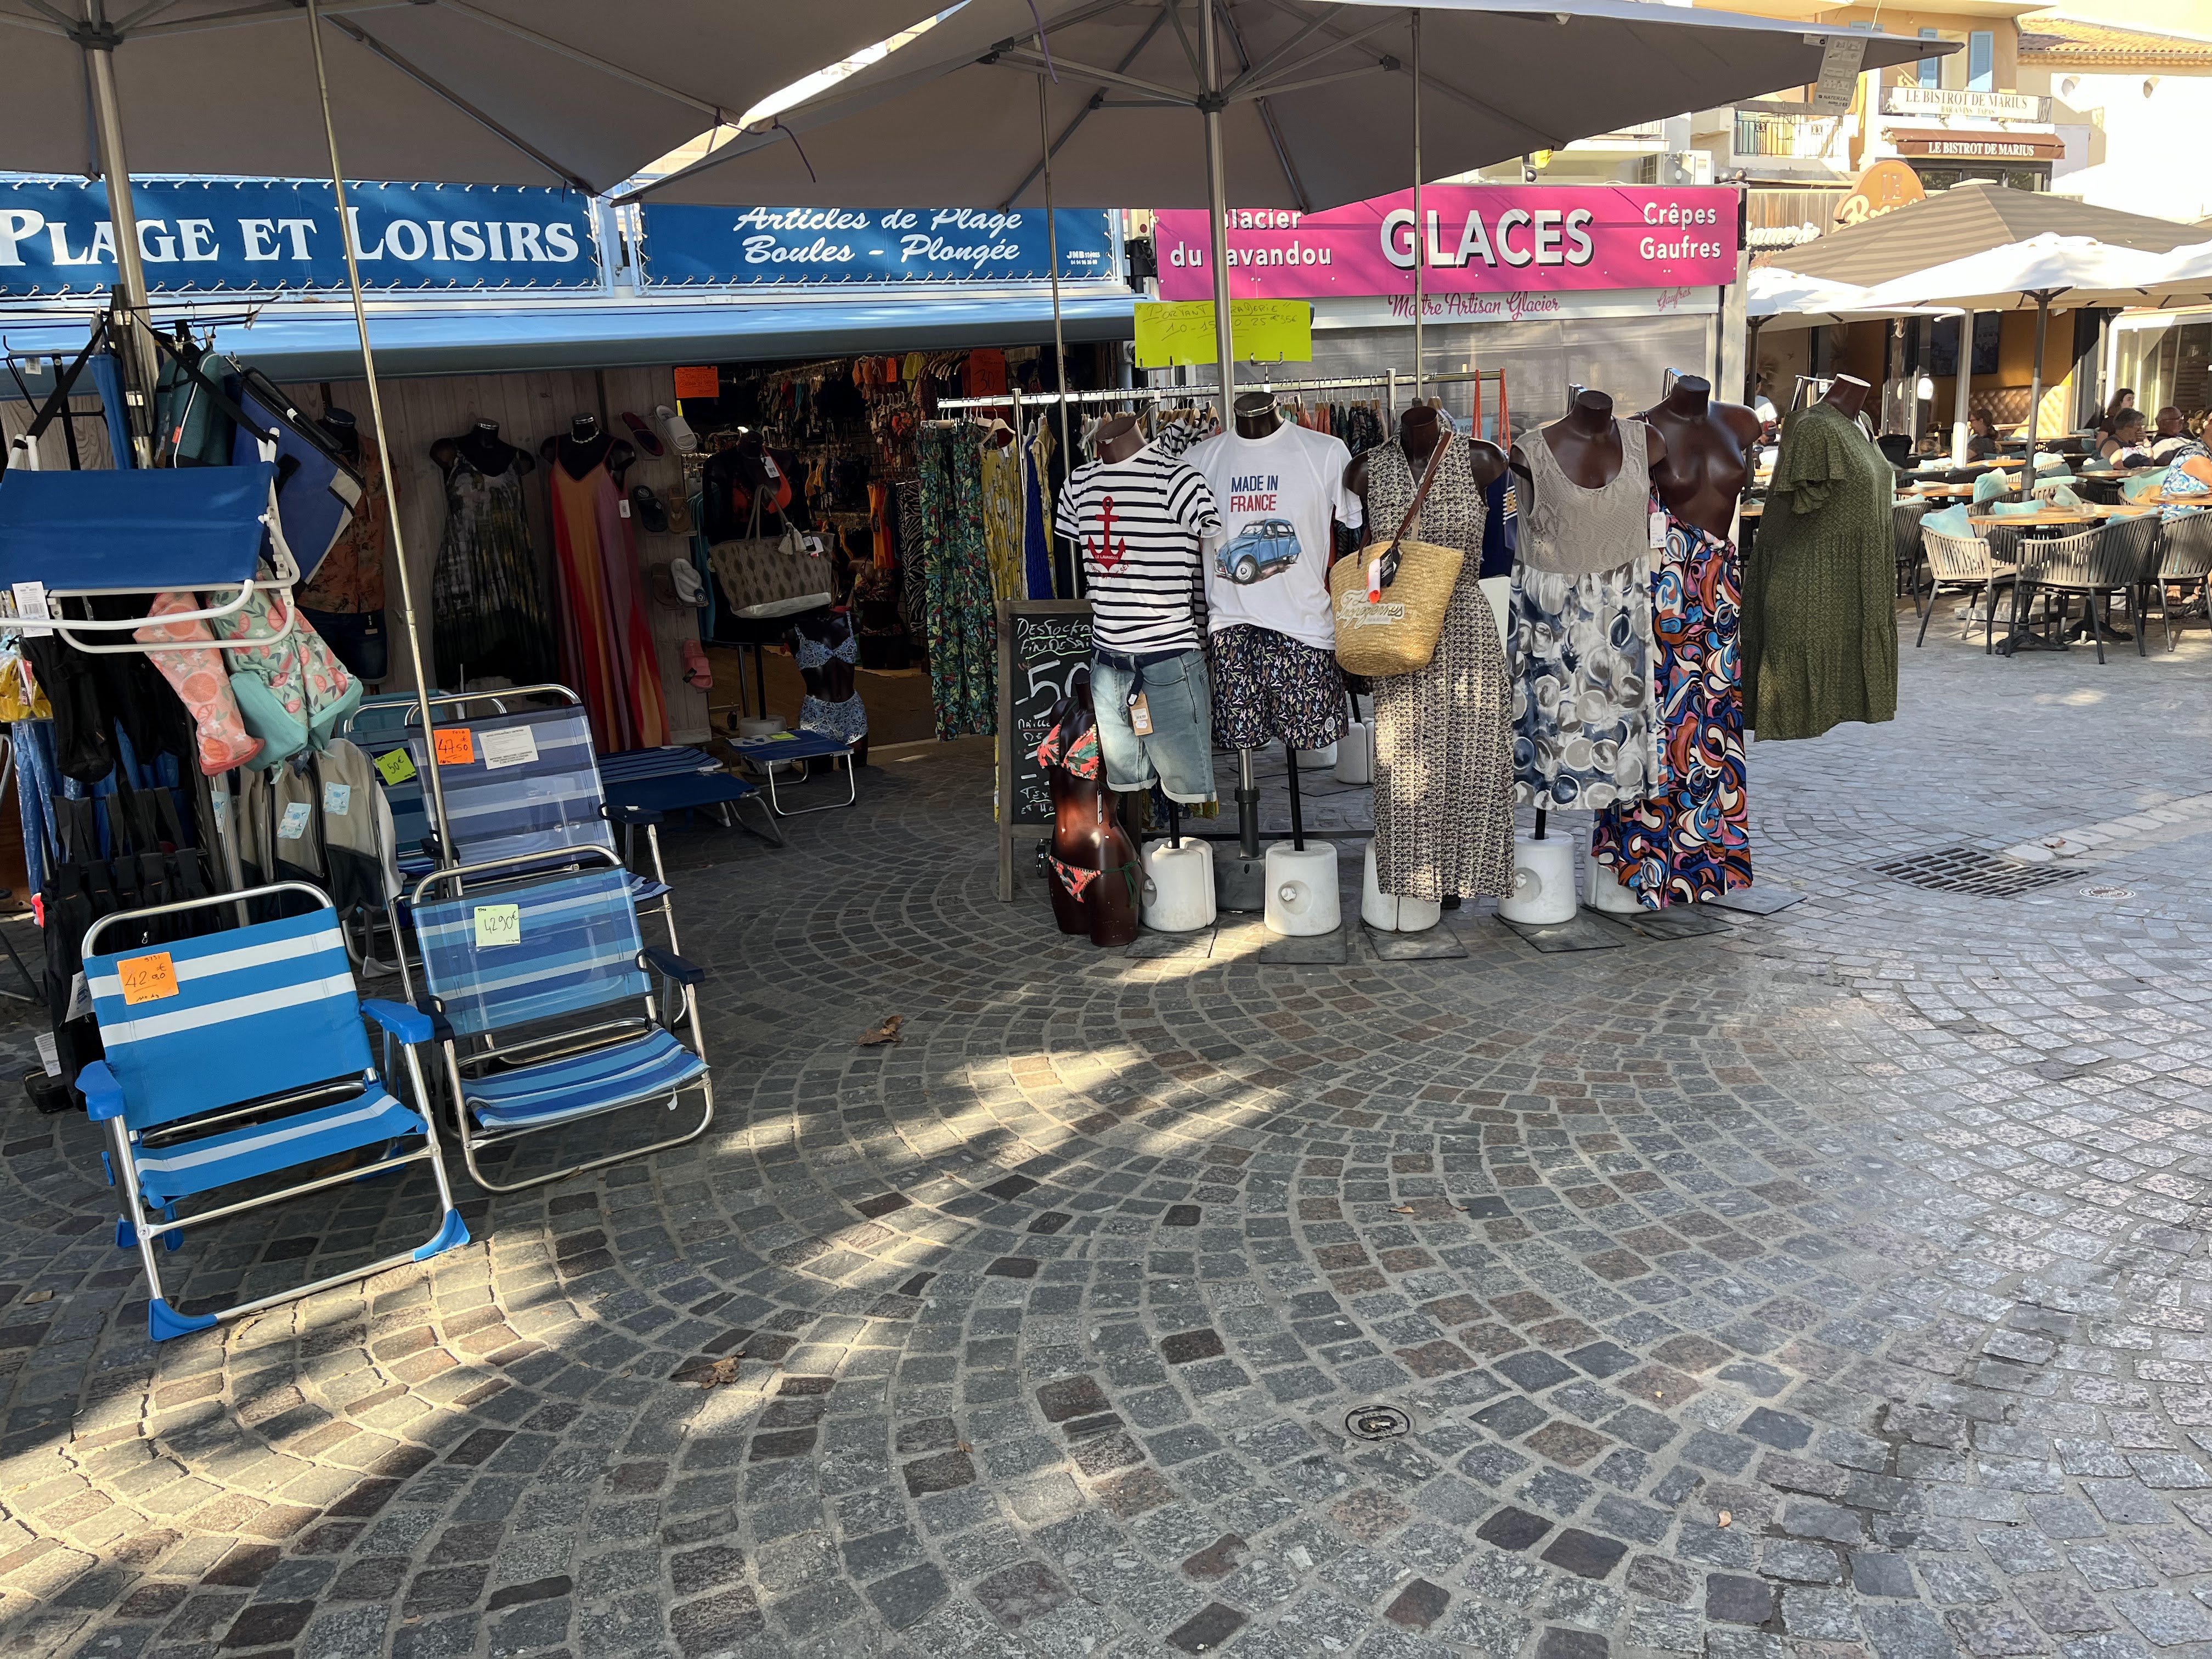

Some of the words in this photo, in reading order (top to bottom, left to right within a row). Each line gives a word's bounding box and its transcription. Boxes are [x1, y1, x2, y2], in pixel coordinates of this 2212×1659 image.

[1906, 89, 1920, 103] LE
[1923, 91, 1970, 105] BISTROT
[1972, 94, 1985, 106] DE
[1988, 95, 2028, 109] MARIUS
[1928, 142, 1942, 154] LE
[1943, 142, 1984, 155] BISTROT
[1984, 143, 1997, 155] DE
[1998, 144, 2034, 156] MARIUS
[733, 206, 871, 232] Articles
[881, 208, 918, 229] de
[930, 207, 1022, 238] Plage
[1226, 209, 1302, 229] lacier
[1643, 202, 1717, 231] Crêpes
[0, 208, 219, 266] PLAGE
[238, 218, 317, 262] ET
[334, 206, 579, 262] LOISIRS
[1380, 208, 1593, 268] GLACES
[1639, 235, 1721, 261] Gaufres
[742, 235, 856, 264] Boules
[900, 234, 1020, 269] Plongée
[1170, 241, 1203, 267] du
[1227, 240, 1332, 267] avandou
[1388, 293, 1443, 318] Matre
[1444, 292, 1501, 316] Artisan
[1506, 291, 1561, 321] Glacier
[1231, 475, 1264, 493] MADE
[1267, 475, 1278, 491] IN
[1230, 494, 1277, 512] FRANCE
